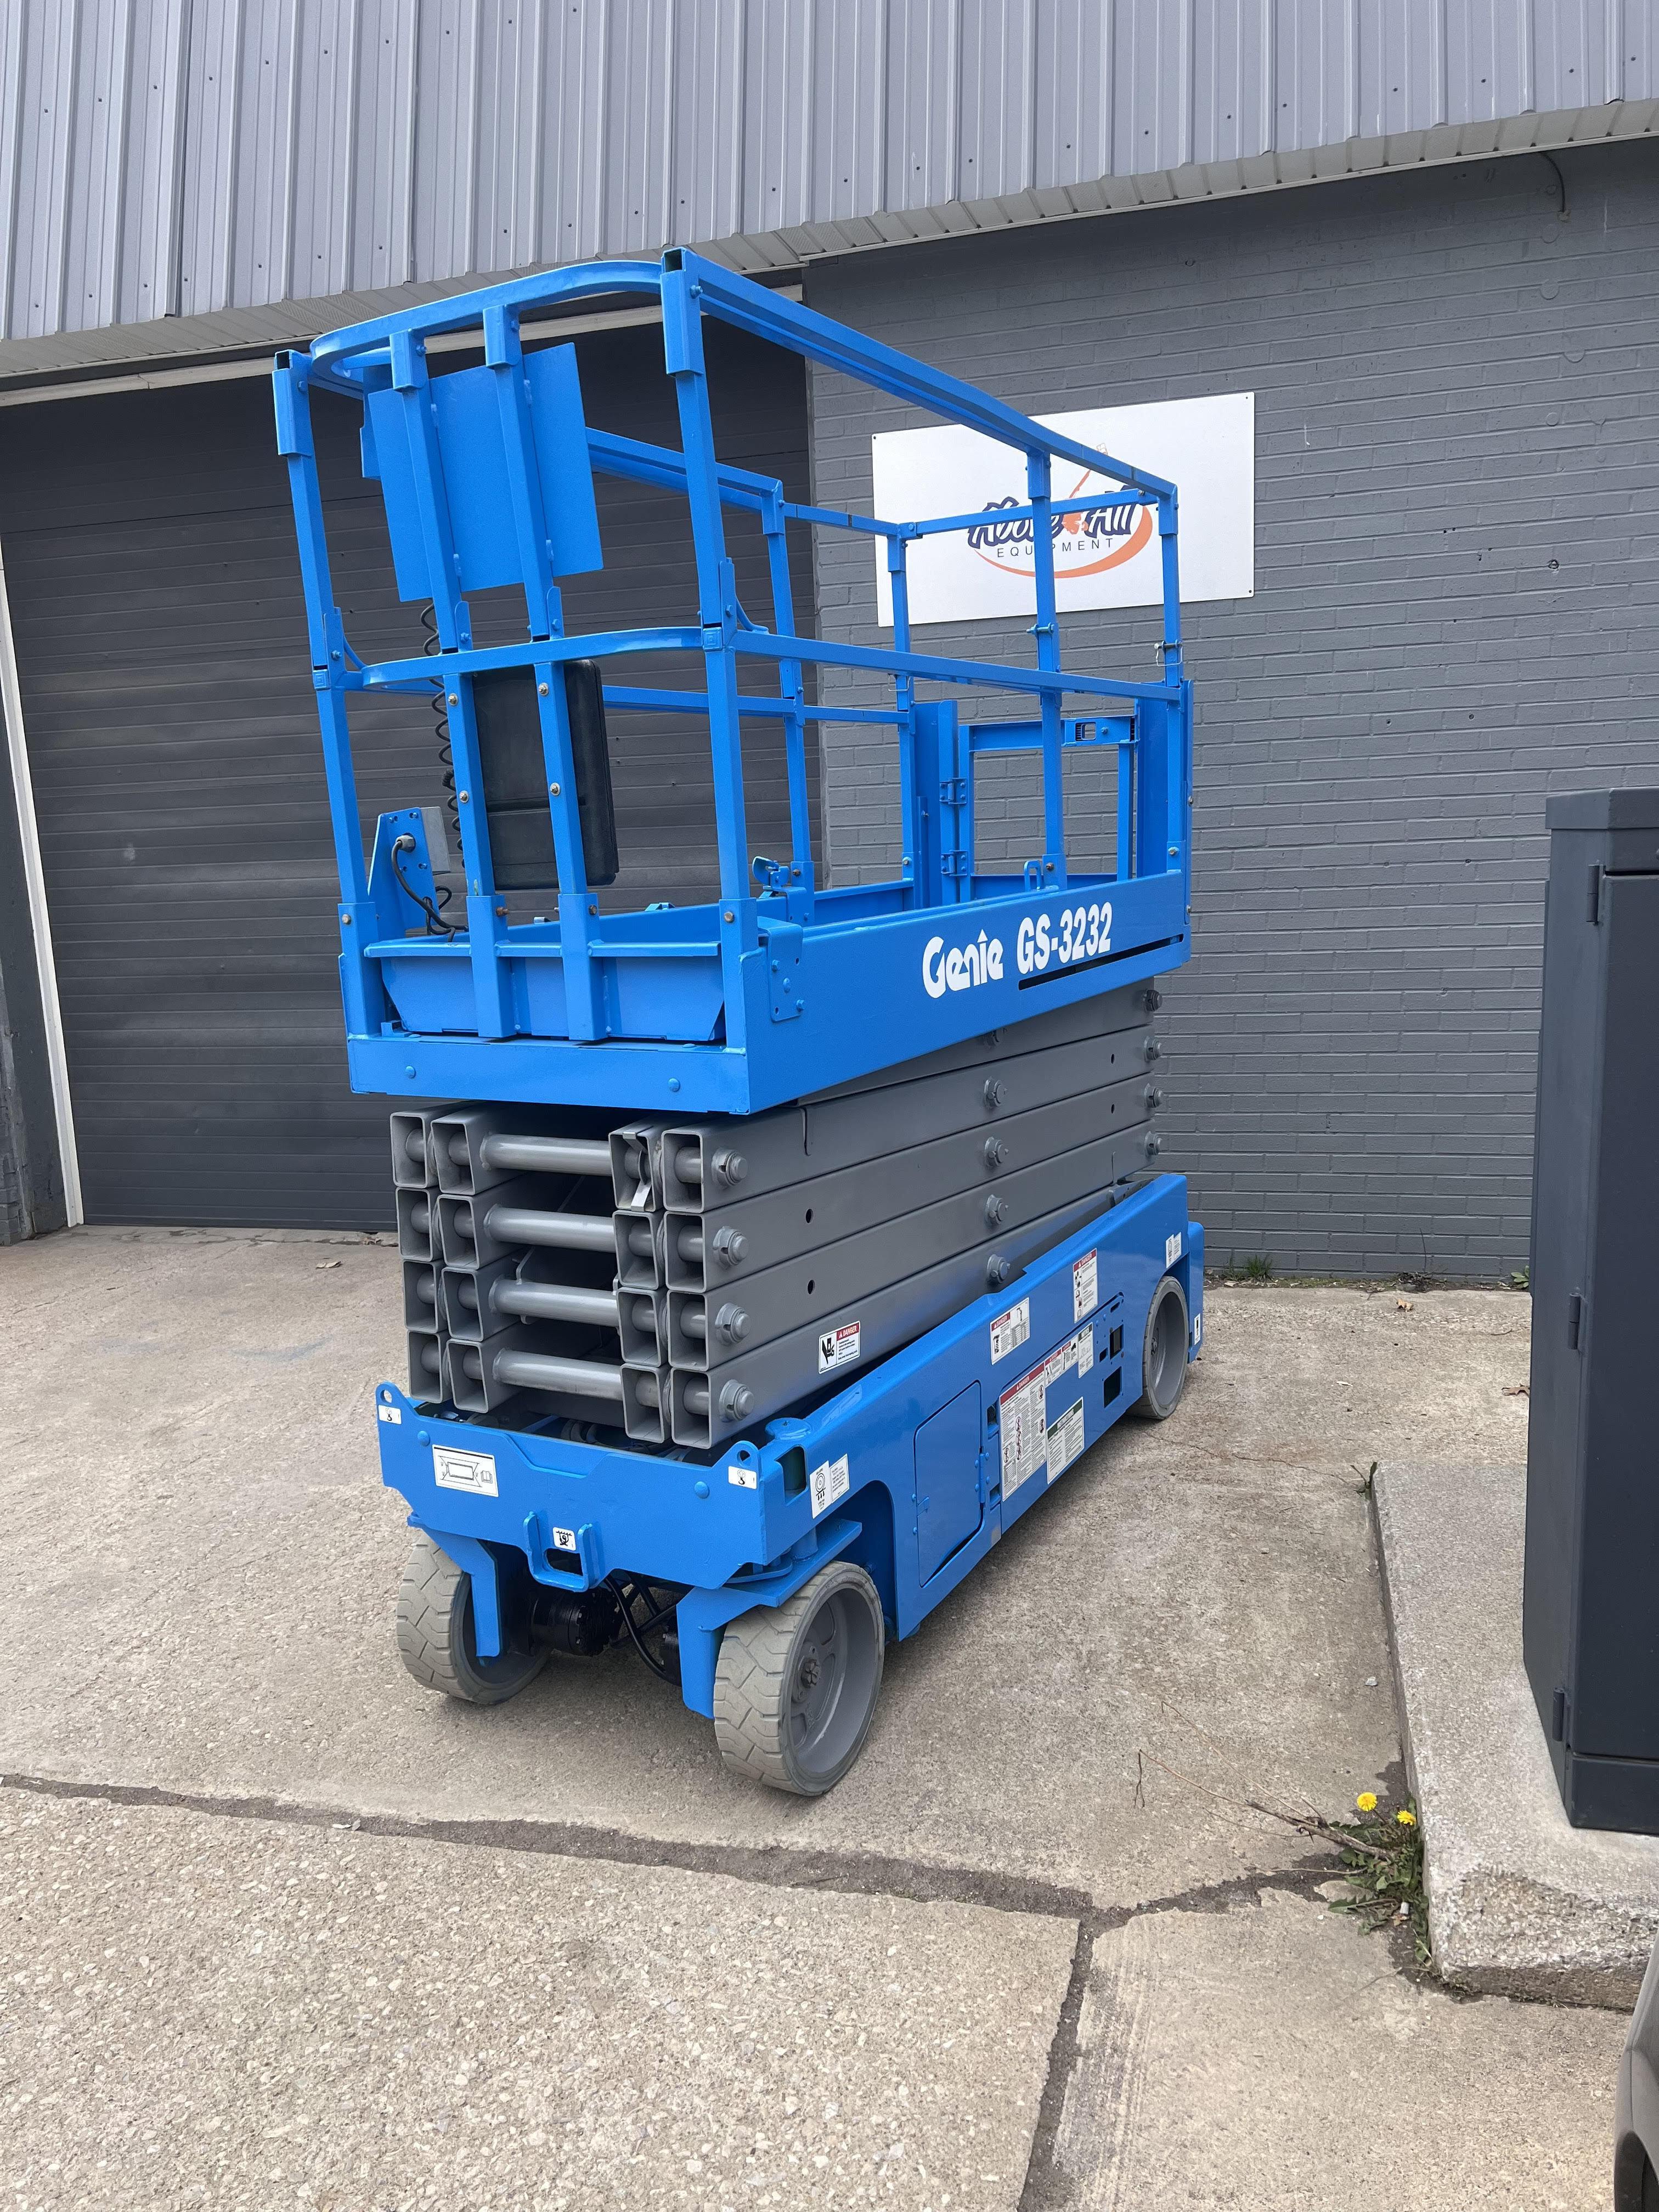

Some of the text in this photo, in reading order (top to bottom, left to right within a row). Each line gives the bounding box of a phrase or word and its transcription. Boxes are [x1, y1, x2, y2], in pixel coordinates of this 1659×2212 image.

[1084, 485, 1136, 539] All
[922, 902, 1113, 998] Genie GS-3232
[843, 1325, 857, 1337] DANGER
